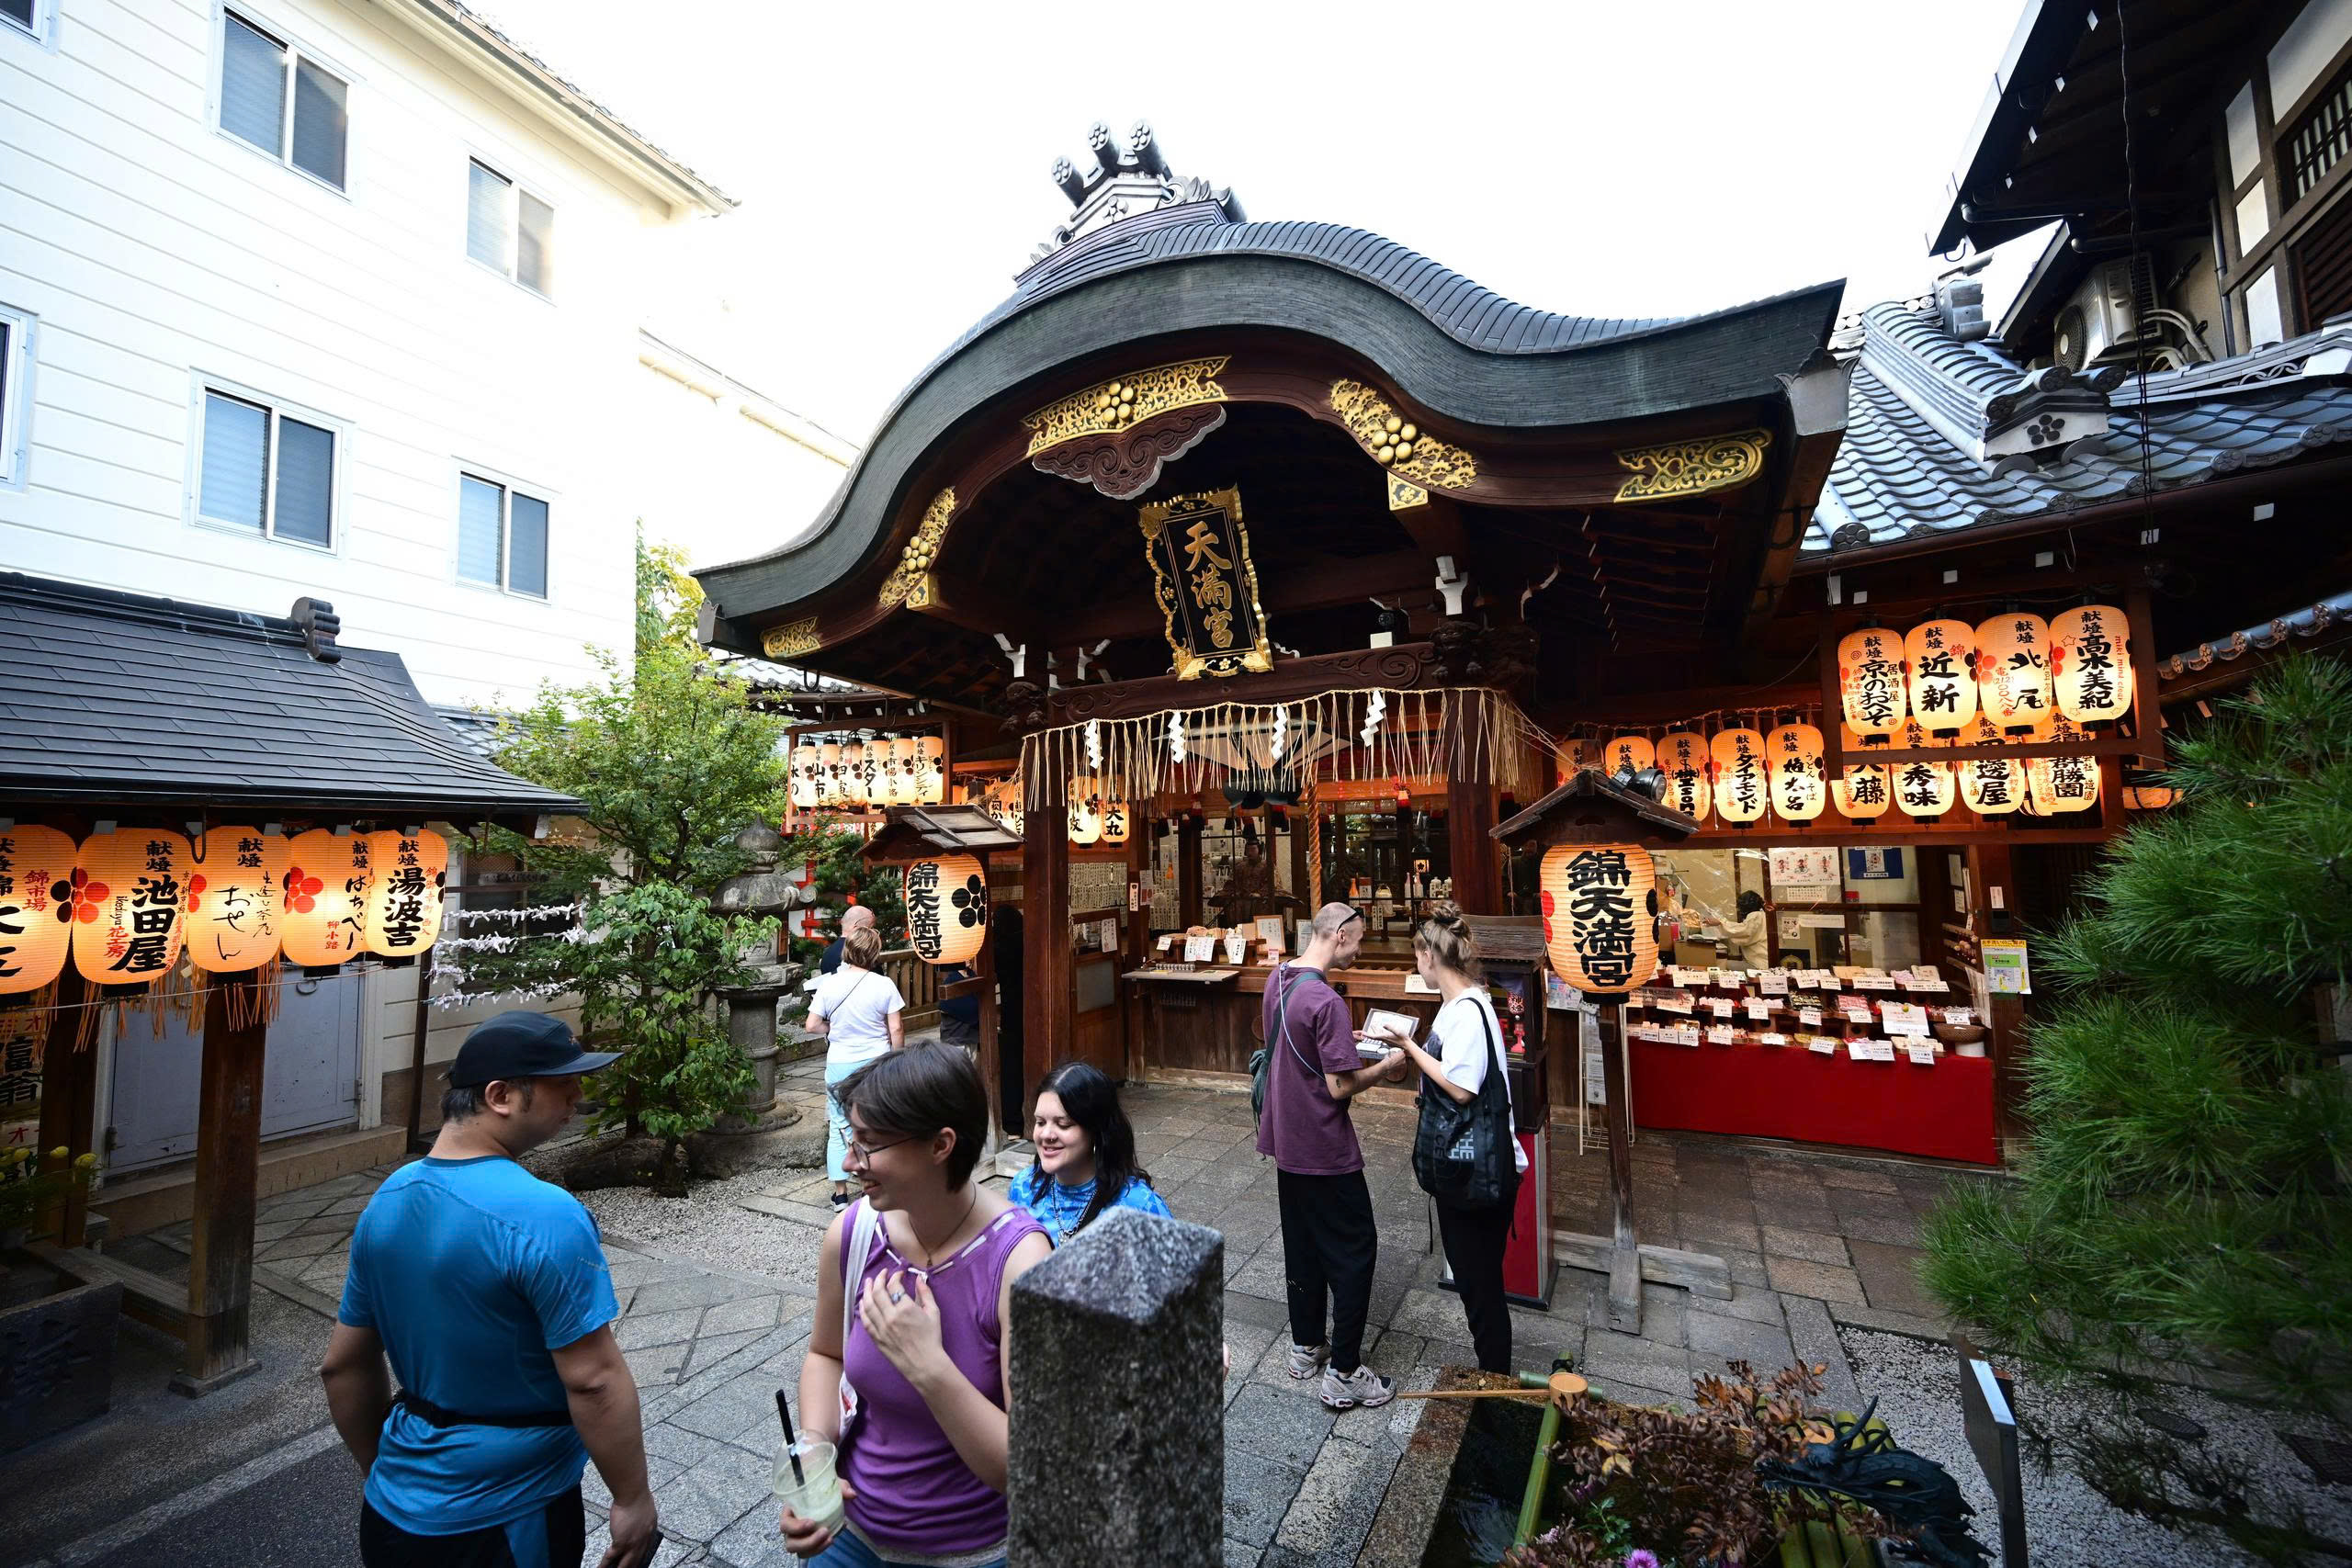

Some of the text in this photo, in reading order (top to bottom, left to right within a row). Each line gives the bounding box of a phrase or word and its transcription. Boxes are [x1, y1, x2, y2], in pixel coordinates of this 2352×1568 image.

[1858, 660, 1893, 727] 京のおへそ
[1886, 664, 1899, 702] 居酒屋
[1918, 651, 1960, 713] 近新
[865, 759, 876, 797] スター
[1736, 754, 1758, 814] ダイアモンド
[1106, 807, 1124, 837] 大丸
[22, 869, 51, 912] 錦市場
[383, 866, 426, 947] 湯波吉
[1566, 850, 1637, 987] 錦天満宮
[106, 874, 180, 974] 池田屋
[213, 885, 251, 961] おせん
